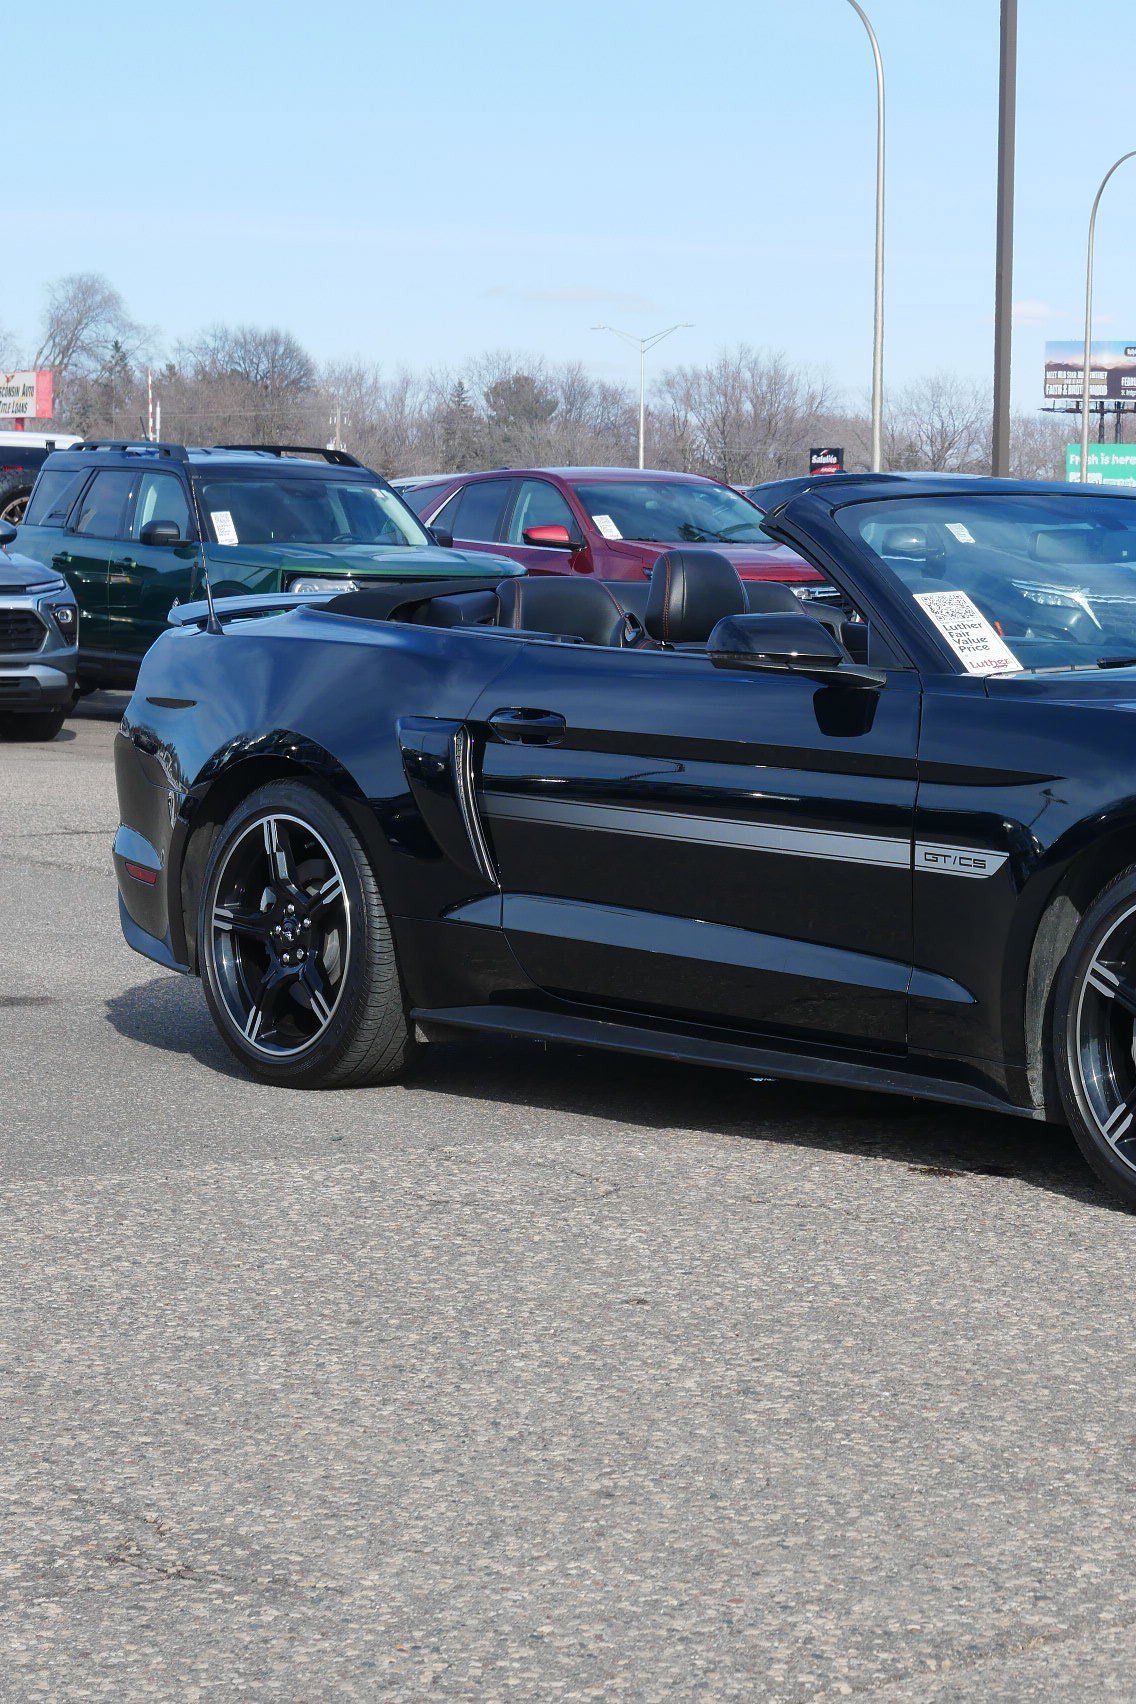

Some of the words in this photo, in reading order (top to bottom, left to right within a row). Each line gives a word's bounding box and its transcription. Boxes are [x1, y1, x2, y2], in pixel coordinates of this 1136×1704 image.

[22, 383, 35, 397] AUTO
[11, 401, 28, 414] LOANS
[1070, 453, 1098, 465] Frsh
[1101, 452, 1110, 465] is
[943, 622, 982, 631] Luther
[948, 631, 970, 639] Fair
[952, 637, 988, 645] Value
[959, 644, 990, 653] Price
[969, 658, 1009, 669] Luther
[924, 852, 987, 869] GT/CS
